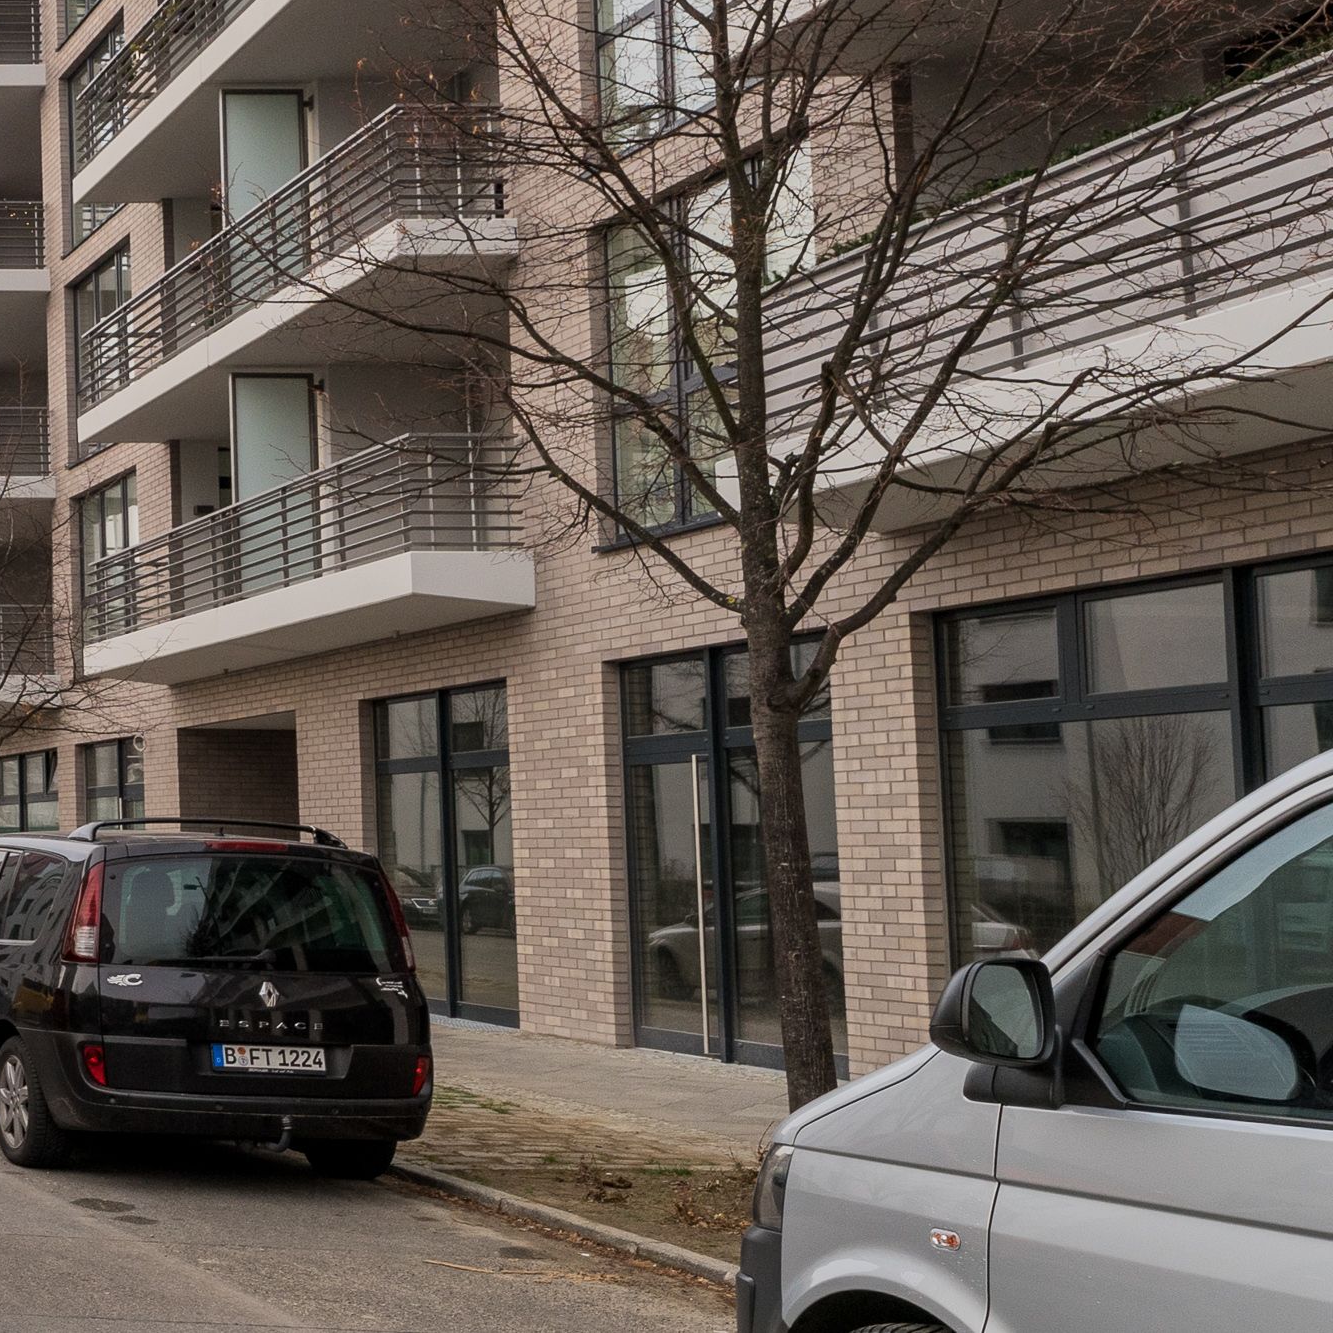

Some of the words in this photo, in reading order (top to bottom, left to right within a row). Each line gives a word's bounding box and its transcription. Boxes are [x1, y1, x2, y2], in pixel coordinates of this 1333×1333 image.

[219, 1019, 324, 1030] ESPACE
[224, 1047, 237, 1065] B
[249, 1048, 272, 1066] FT
[278, 1049, 323, 1068] 1224
